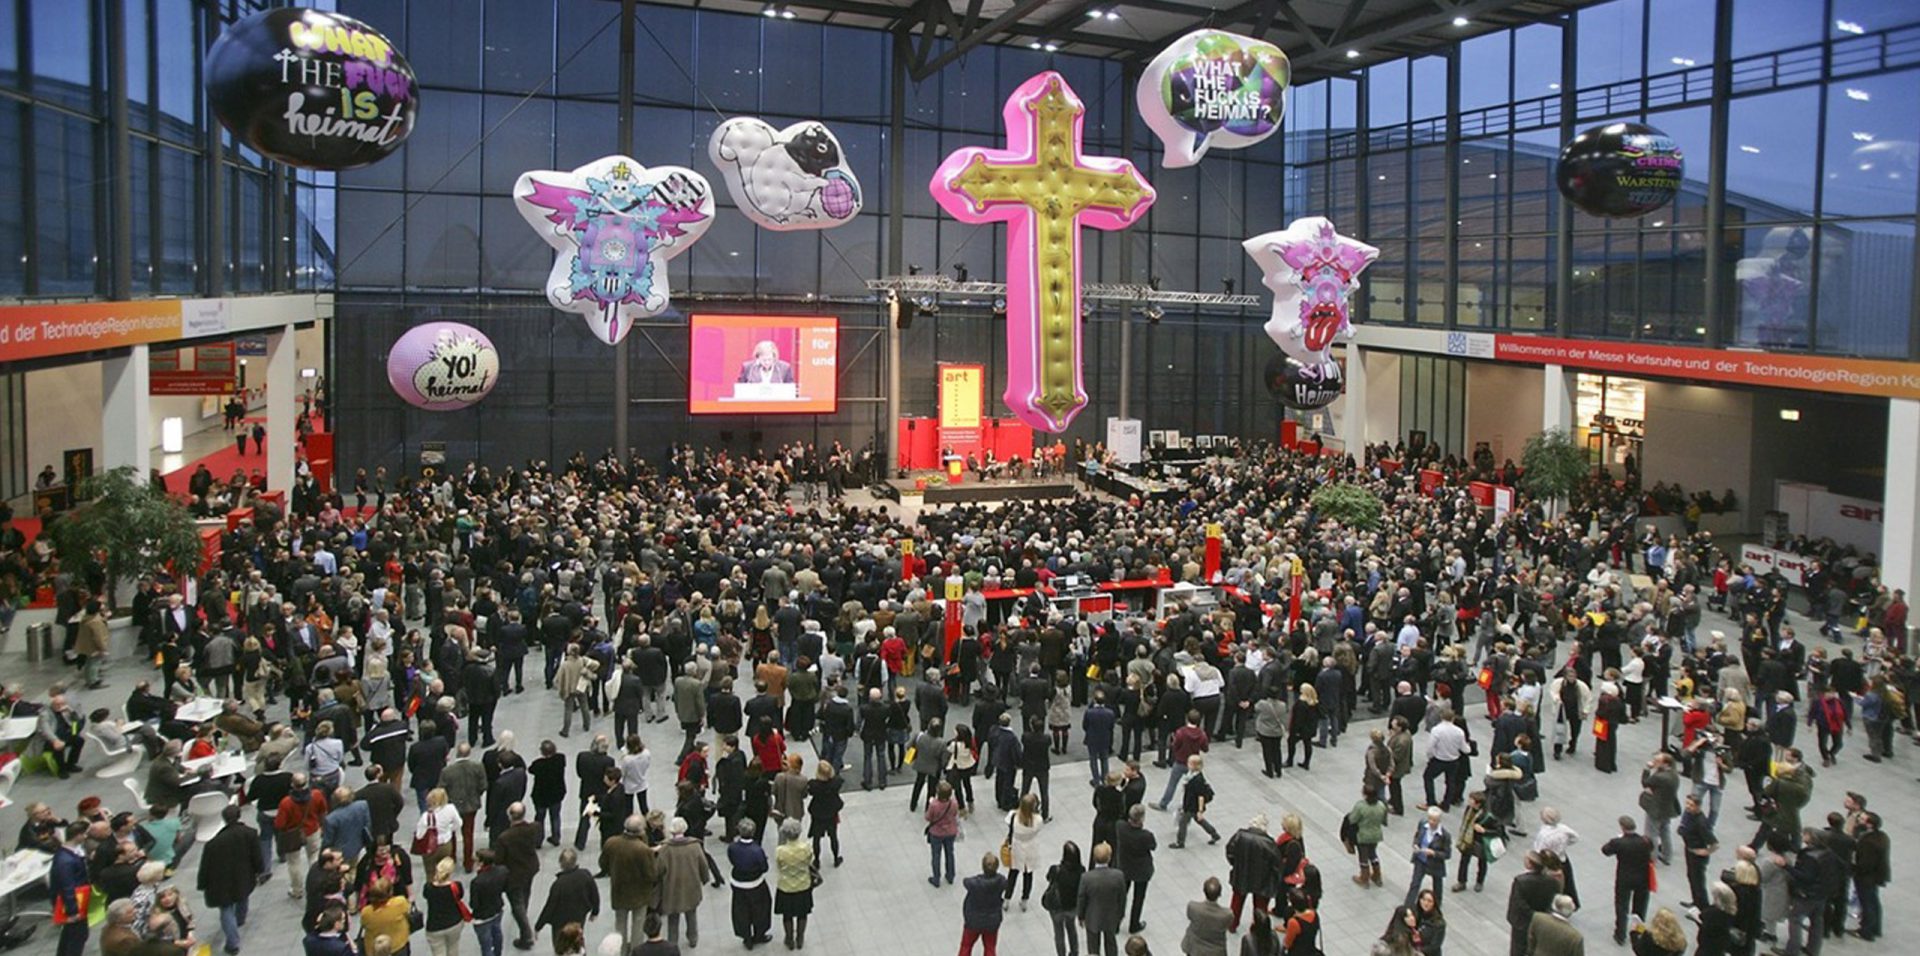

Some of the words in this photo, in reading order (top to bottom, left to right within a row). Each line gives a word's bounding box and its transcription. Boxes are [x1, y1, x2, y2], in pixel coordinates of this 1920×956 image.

[289, 21, 393, 65] WHAT
[273, 48, 342, 89] THE
[344, 61, 412, 101] FUCK
[1193, 61, 1241, 76] WHAT
[1194, 75, 1227, 90] THE
[341, 87, 379, 119] IS
[1195, 89, 1240, 105] FUCK
[1245, 90, 1261, 105] IS
[283, 92, 403, 146] heimat
[1194, 103, 1271, 120] HEIMAT?
[15, 323, 37, 342] der
[442, 354, 476, 379] YO!
[1499, 342, 1556, 357] Willkommen
[1568, 349, 1586, 359] der
[1588, 350, 1624, 363] Messe
[1627, 353, 1682, 368] Karlsruhe
[1685, 358, 1710, 370] und
[1715, 361, 1739, 374] der
[425, 368, 489, 397] heimat
[1744, 551, 1772, 565] art
